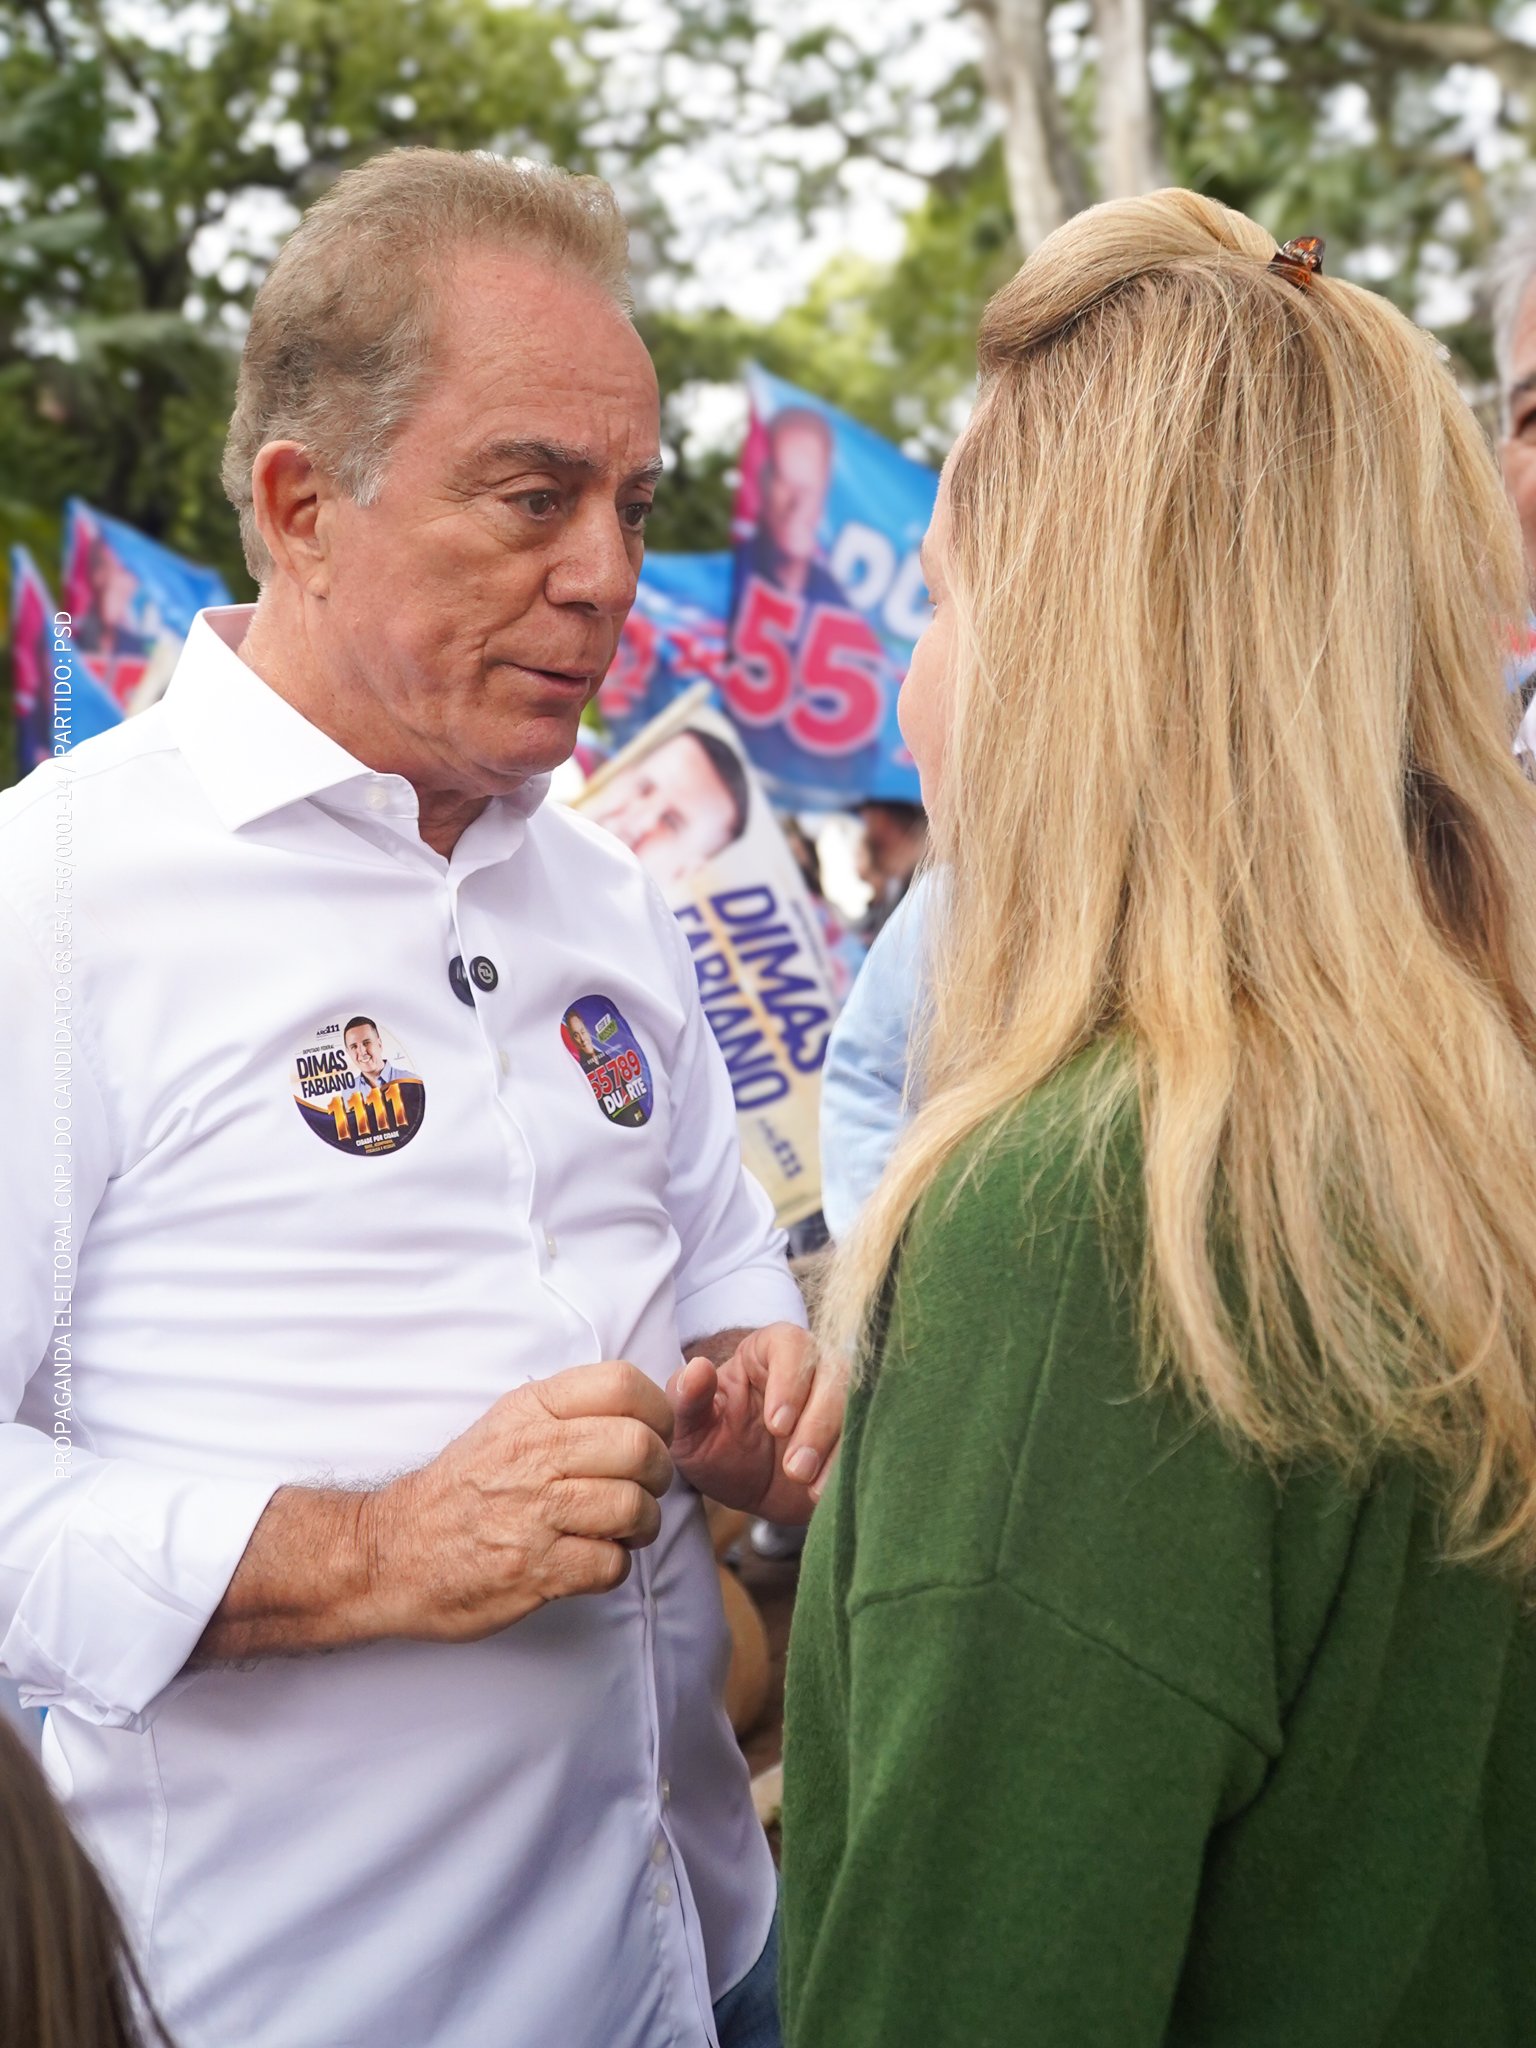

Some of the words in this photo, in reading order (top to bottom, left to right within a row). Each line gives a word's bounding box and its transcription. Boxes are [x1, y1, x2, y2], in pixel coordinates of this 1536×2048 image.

[722, 577, 887, 755] 55
[709, 885, 832, 1075] DIMAS
[296, 1050, 348, 1079] DIMAS
[301, 1072, 356, 1099] FABIANO
[587, 1049, 641, 1101] 55789
[327, 1083, 409, 1141] 1111
[602, 1078, 648, 1115] DUARTE
